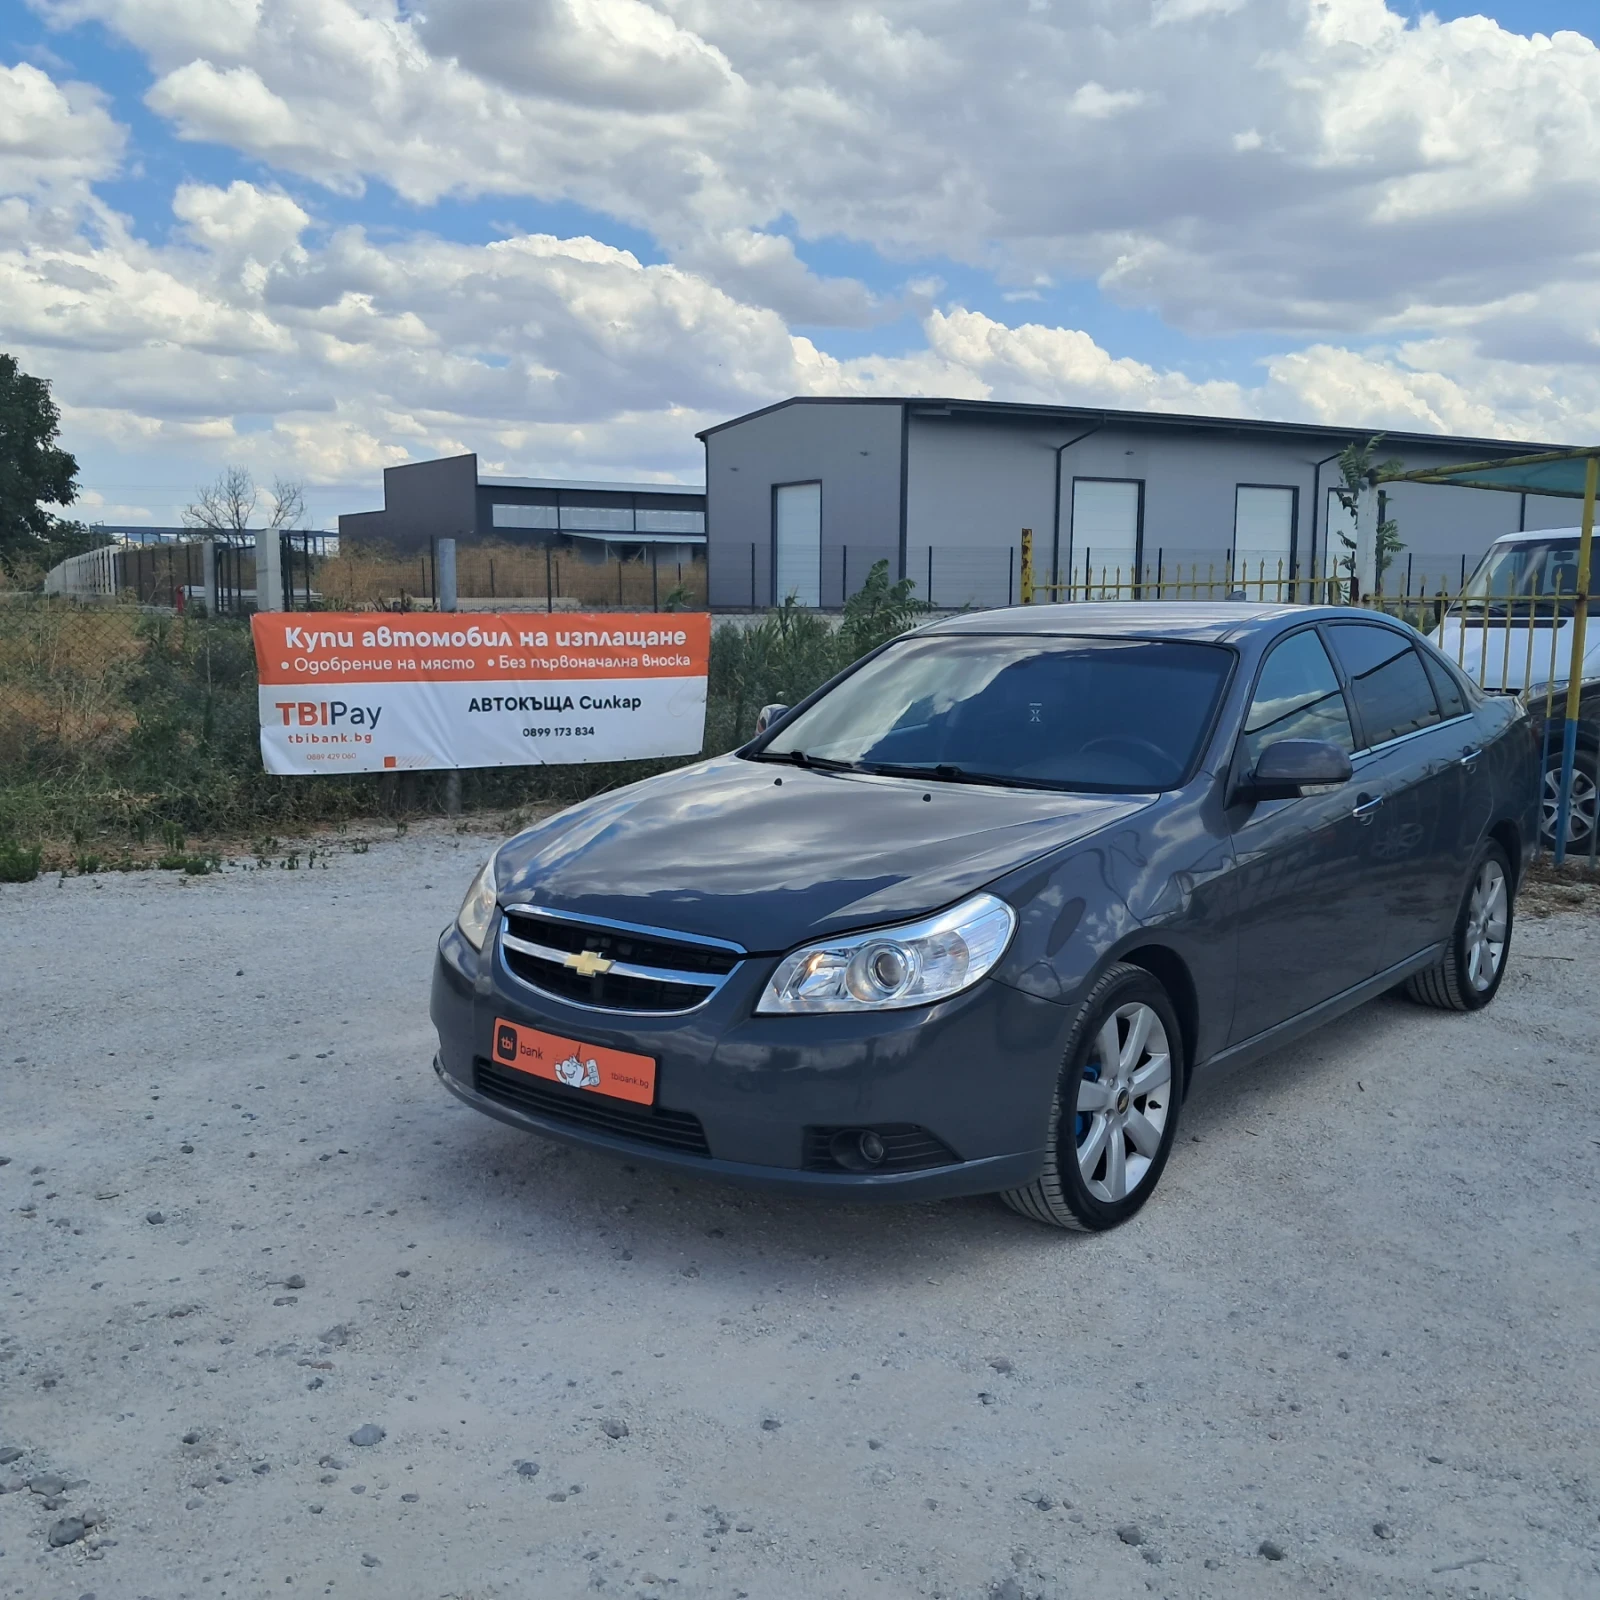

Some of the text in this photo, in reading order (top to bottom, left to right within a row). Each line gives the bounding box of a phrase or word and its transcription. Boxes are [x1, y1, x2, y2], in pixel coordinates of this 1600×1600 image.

[285, 626, 687, 653] Купи автомобил на изплащане
[294, 656, 476, 675] Одобрение на място
[499, 652, 691, 671] Без първоначална вноска
[468, 695, 642, 713] АВТОКЪЩА Силкар
[275, 701, 382, 730] TBIPay
[288, 732, 373, 744] tbibank.bg
[522, 726, 595, 738] 0899 173 834
[327, 752, 340, 760] 429
[501, 1036, 544, 1060] tbi bank
[610, 1072, 649, 1089] tbibank.bg
